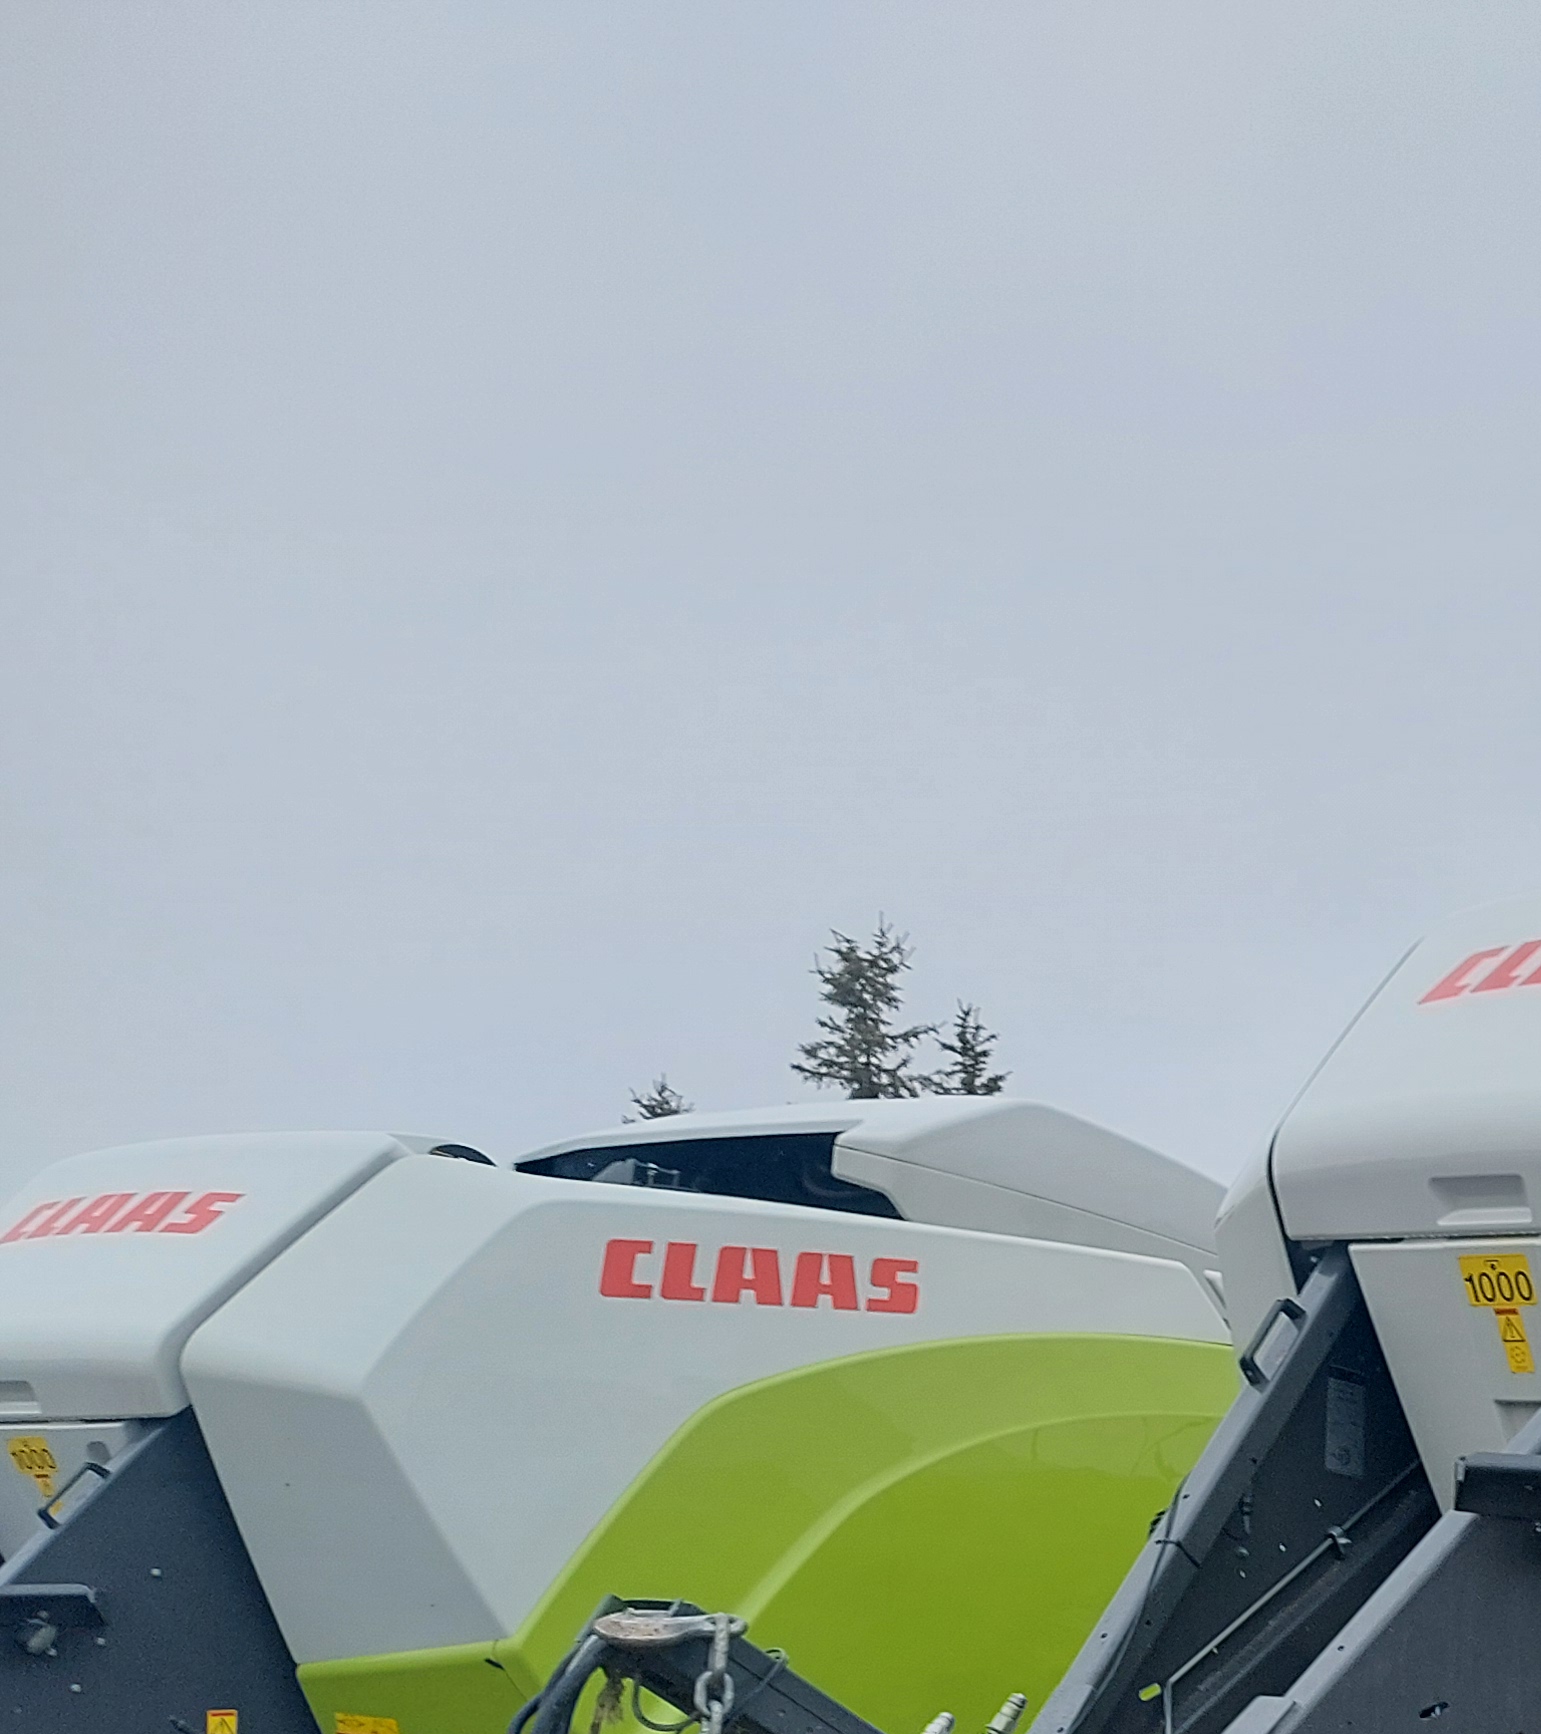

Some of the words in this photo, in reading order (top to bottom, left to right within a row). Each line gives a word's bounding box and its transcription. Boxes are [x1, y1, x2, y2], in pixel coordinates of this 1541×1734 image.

[0, 1191, 246, 1244] CLAAS
[599, 1238, 919, 1315] CLAAS
[1464, 1271, 1532, 1302] 1000
